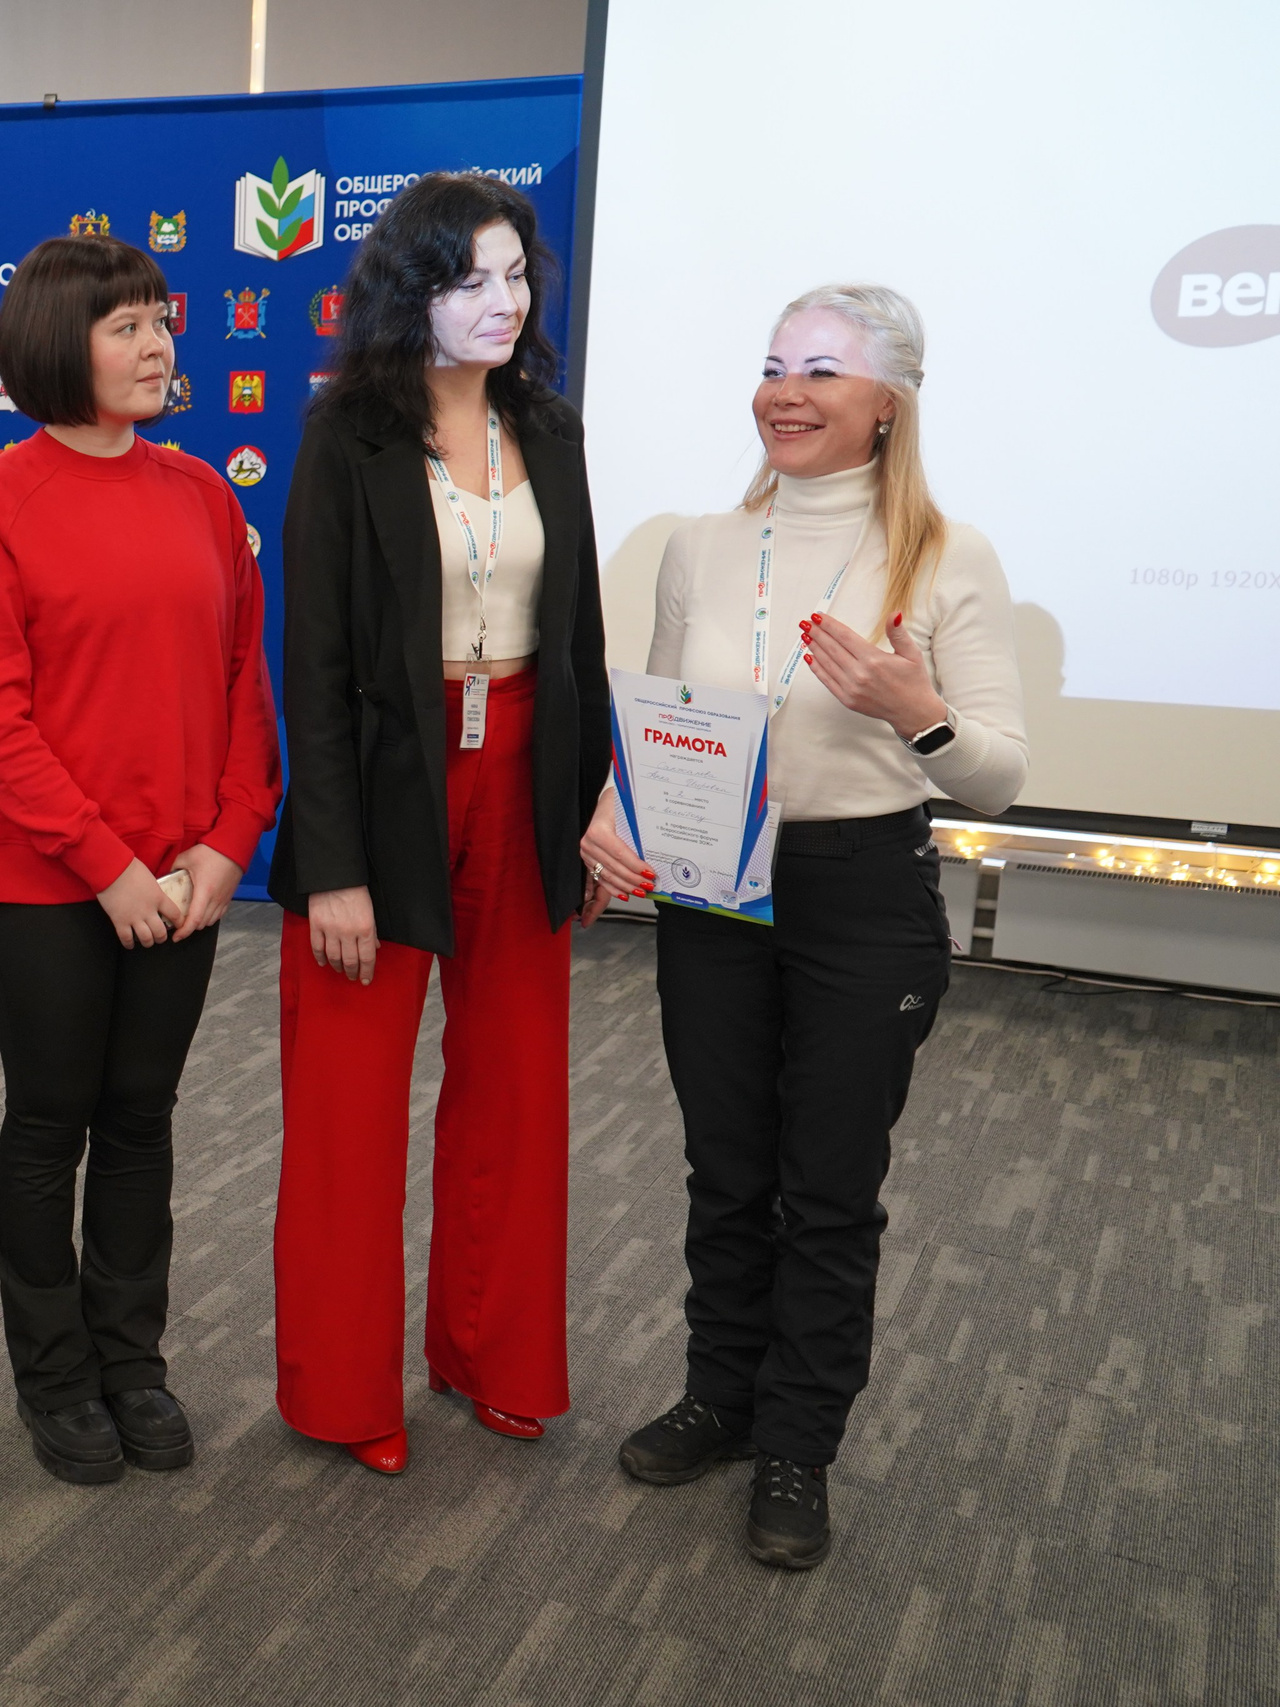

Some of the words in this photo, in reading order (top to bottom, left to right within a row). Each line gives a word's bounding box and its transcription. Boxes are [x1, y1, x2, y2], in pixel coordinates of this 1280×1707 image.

[1129, 567, 1199, 591] 1080p
[1210, 570, 1280, 590] 1920X
[634, 697, 677, 709] ОБЩЕРОССИЙСКИЙ
[679, 706, 706, 715] ПРОФСОЮЗ
[707, 711, 741, 721] ОБРАЗОВАНИЯ
[658, 713, 712, 728] ПРОДВИЖЕНИЕ
[644, 728, 727, 757] ГРАМОТА
